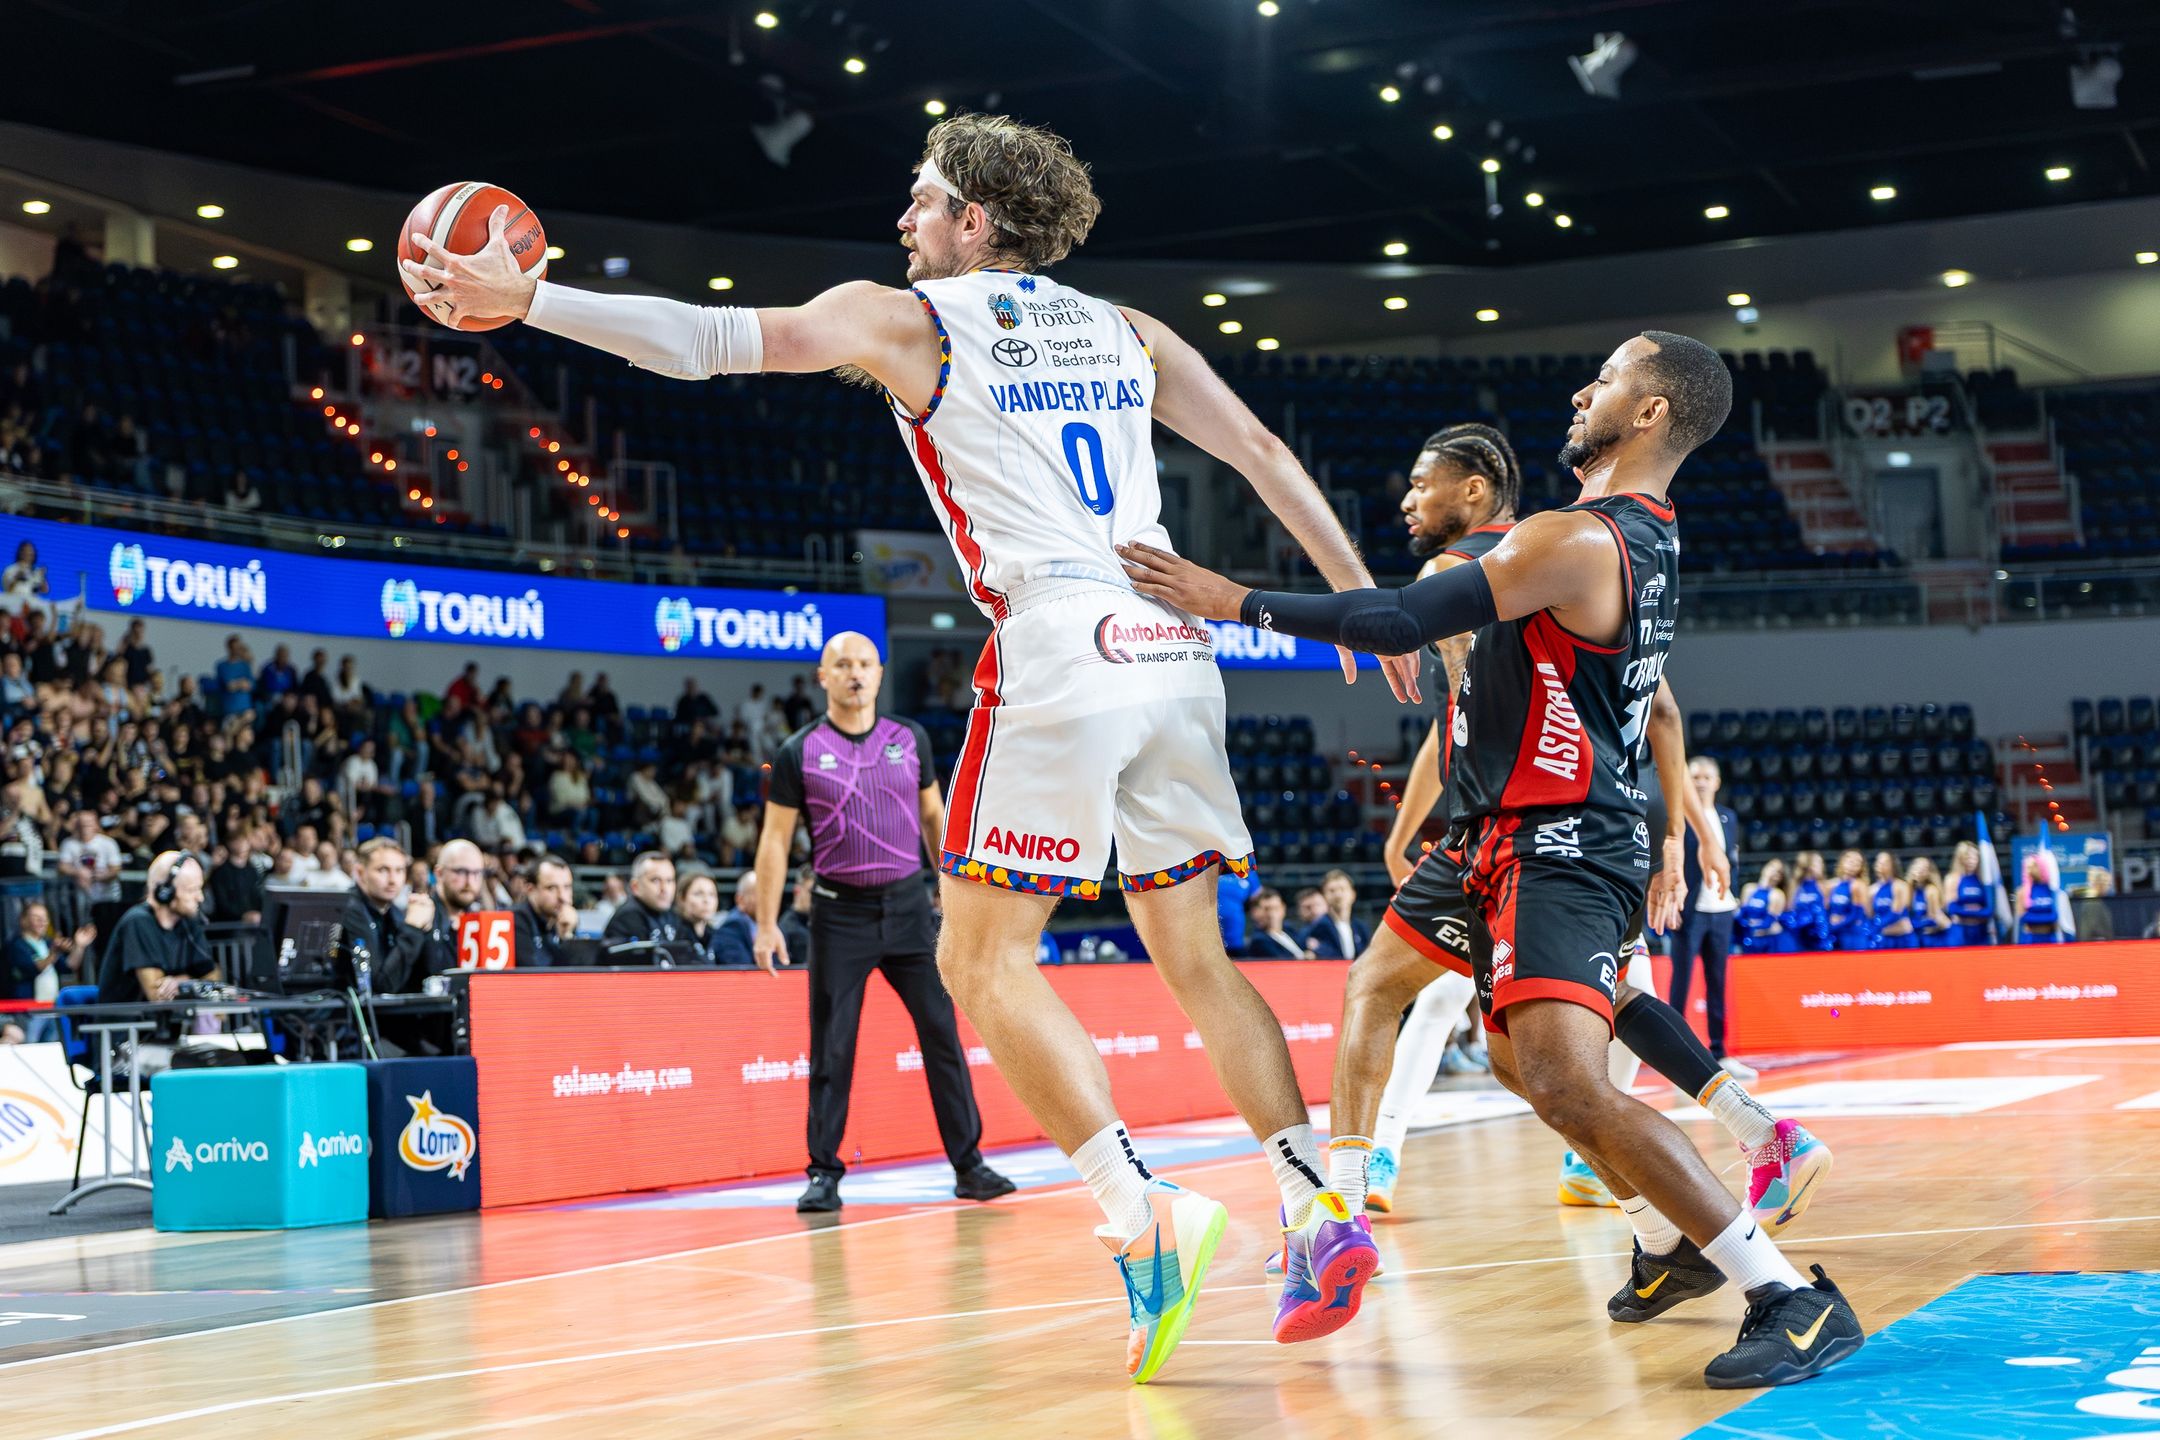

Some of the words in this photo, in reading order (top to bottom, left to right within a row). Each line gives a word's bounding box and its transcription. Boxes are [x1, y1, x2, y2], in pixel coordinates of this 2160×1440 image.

[1021, 298, 1079, 312] MIASTO
[1044, 338, 1093, 353] Toyota
[1051, 353, 1121, 368] Bednarscy
[988, 380, 1090, 413] VANDER
[1090, 378, 1145, 411] PLAS
[1061, 422, 1115, 516] 0
[145, 556, 268, 615] TORUŃ
[418, 588, 545, 641] TORUŃ
[692, 603, 824, 652] TORUŃ
[1135, 650, 1189, 664] TRANSPORT
[983, 826, 1081, 863] ANIRO
[195, 1136, 270, 1164] arriva
[317, 1130, 364, 1159] arriva
[418, 1126, 460, 1156] LOTTO
